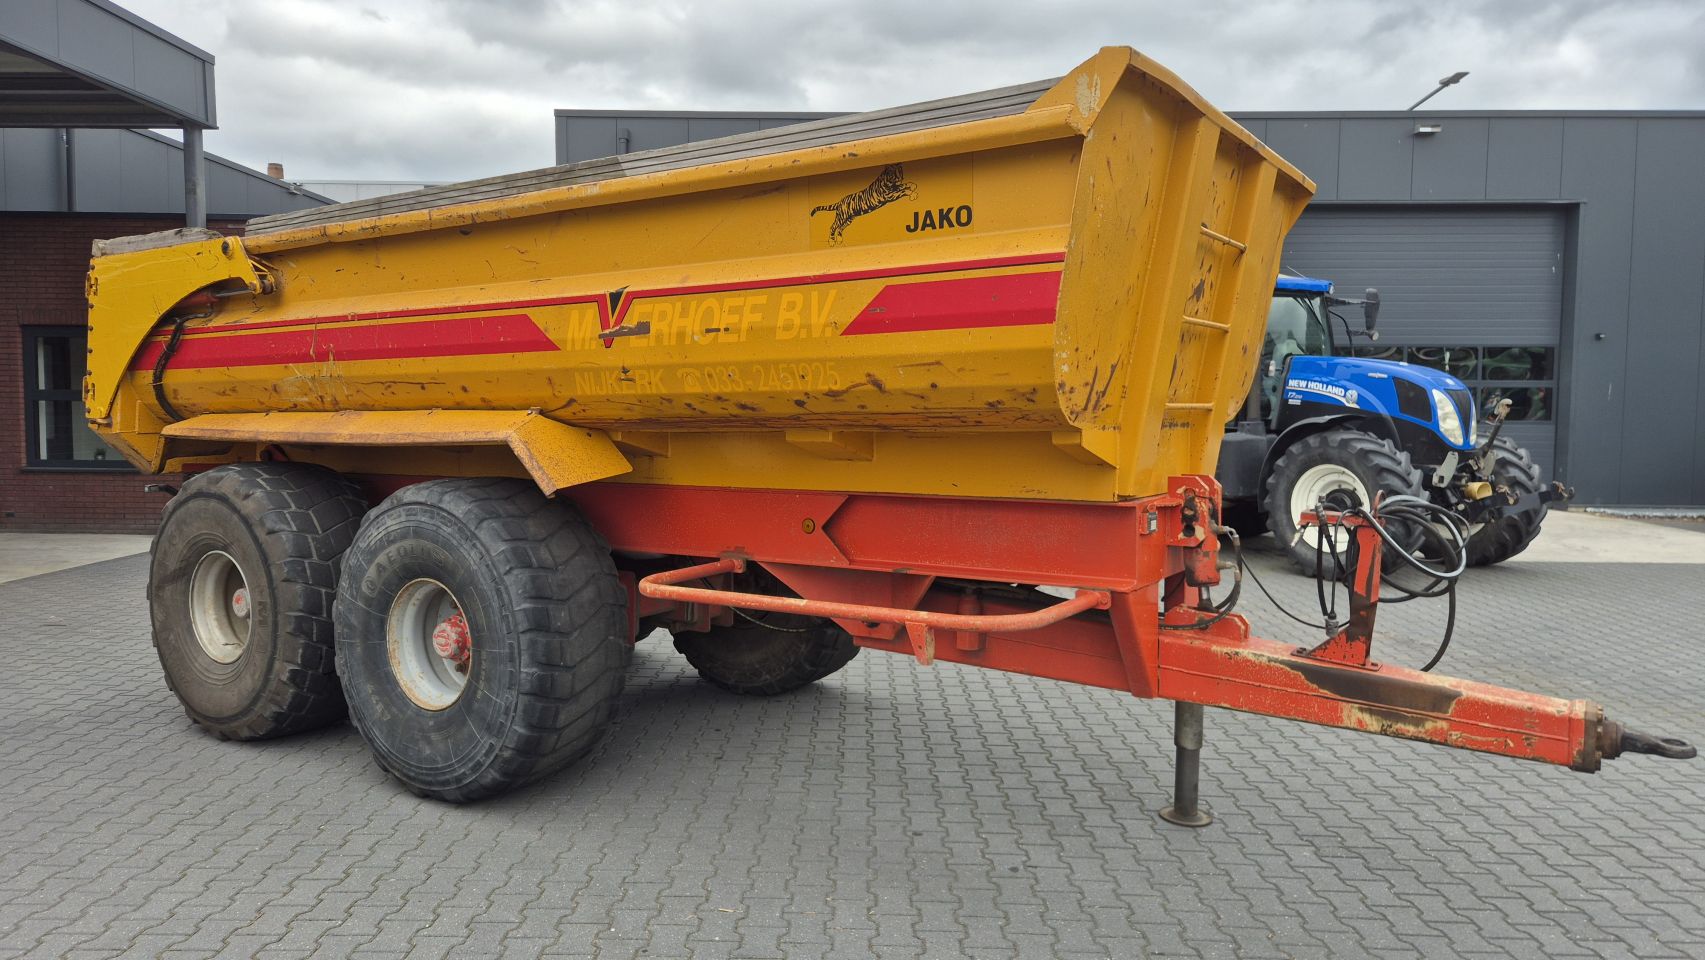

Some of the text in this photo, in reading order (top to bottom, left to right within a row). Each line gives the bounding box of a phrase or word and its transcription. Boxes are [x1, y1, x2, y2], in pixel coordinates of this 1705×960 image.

[906, 204, 973, 233] JAKO
[776, 289, 837, 341] B.V.
[574, 367, 667, 395] NIJKERK
[1288, 379, 1307, 388] NEW
[1308, 380, 1345, 397] HOLLAND
